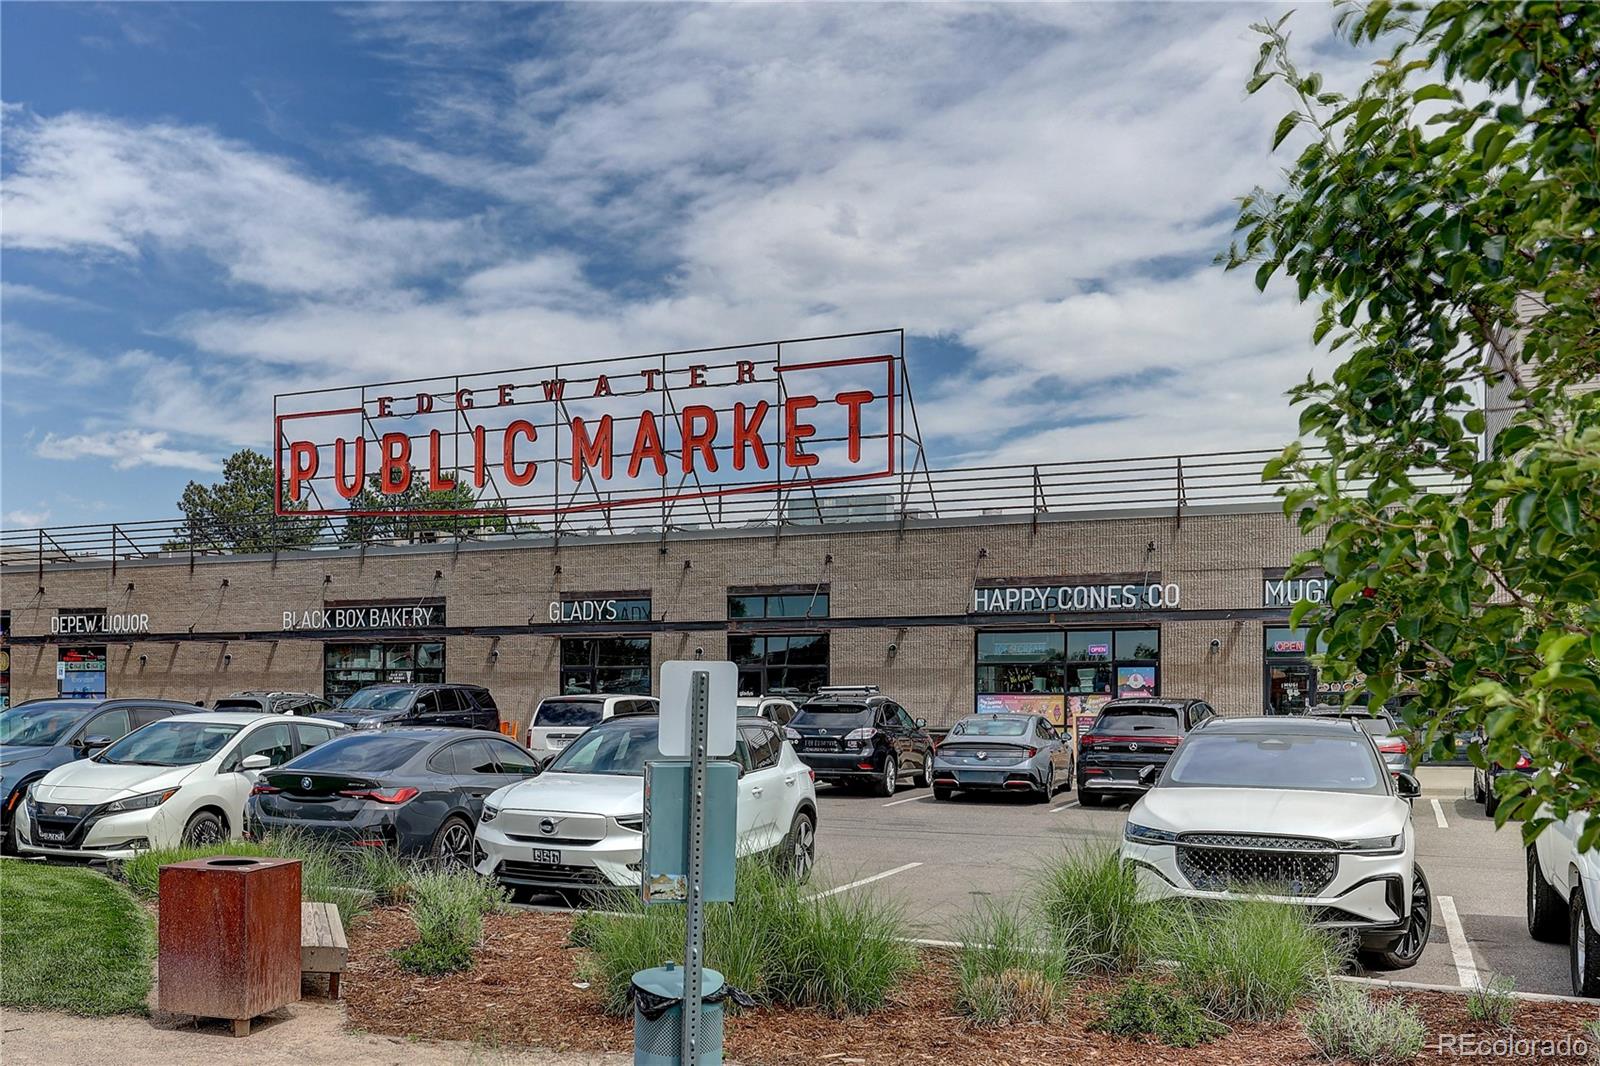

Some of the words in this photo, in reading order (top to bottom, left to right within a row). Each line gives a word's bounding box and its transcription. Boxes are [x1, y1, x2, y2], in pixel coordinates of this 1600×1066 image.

[377, 360, 756, 418] EDGEWATER
[290, 418, 538, 501] PUBLIC
[571, 389, 875, 482] MARKET
[974, 586, 1051, 612] HAPPY
[1057, 585, 1136, 609] CONES
[1149, 583, 1181, 606] CO
[1265, 579, 1328, 604] MUGI
[282, 610, 332, 629] BLACK
[336, 608, 366, 628] BOX
[370, 607, 434, 627] BAKERY
[549, 600, 617, 621] GLADYS
[51, 615, 97, 633] DEPEW
[101, 613, 149, 632] LIQUOR
[1276, 641, 1304, 651] OPEN
